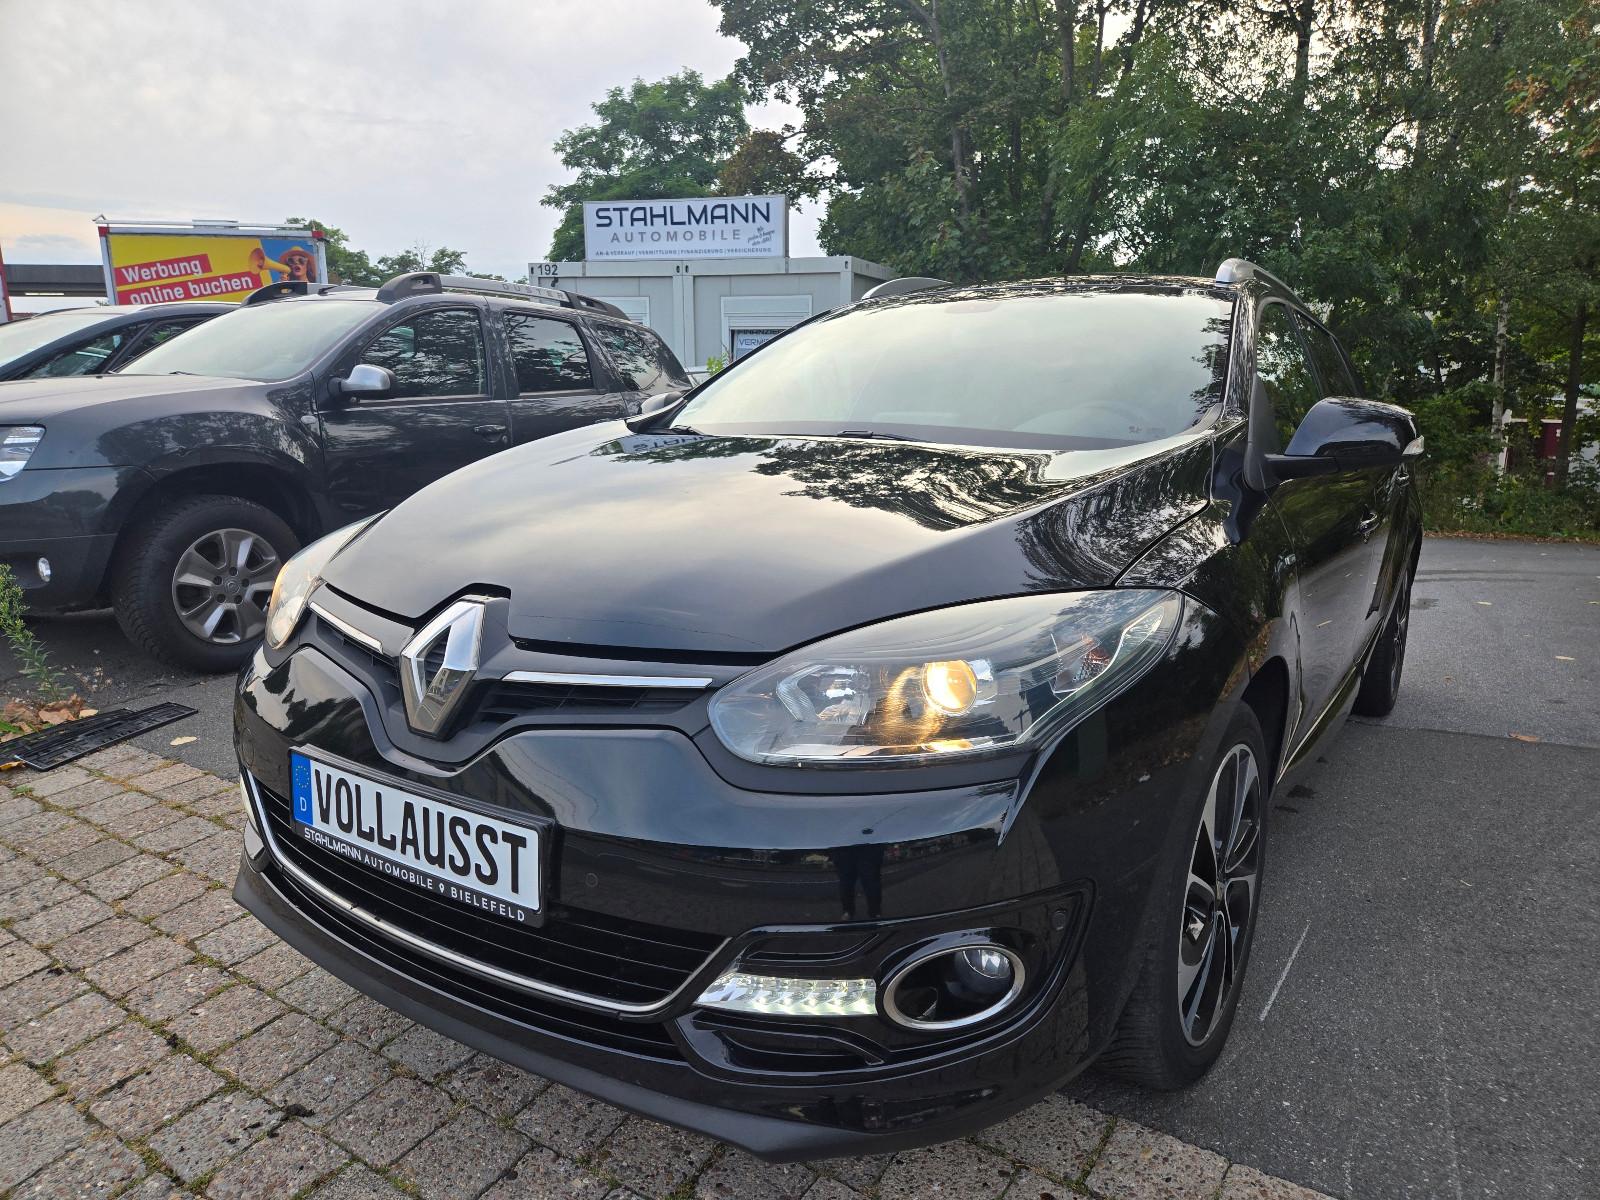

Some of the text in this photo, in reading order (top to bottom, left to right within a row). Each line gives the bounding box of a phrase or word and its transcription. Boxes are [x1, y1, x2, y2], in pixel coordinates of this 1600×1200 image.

[595, 202, 770, 227] STAHLMANN
[611, 229, 741, 243] AUTOMOBILE
[122, 260, 202, 283] Werbung
[537, 264, 558, 275] 192
[130, 275, 253, 305] online buchen
[502, 283, 566, 299] DUSTER
[300, 796, 307, 812] D
[314, 768, 527, 895] VOLLAUSST
[304, 827, 525, 922] STAHLMANN AUTOMOBILE BIELEFELD
